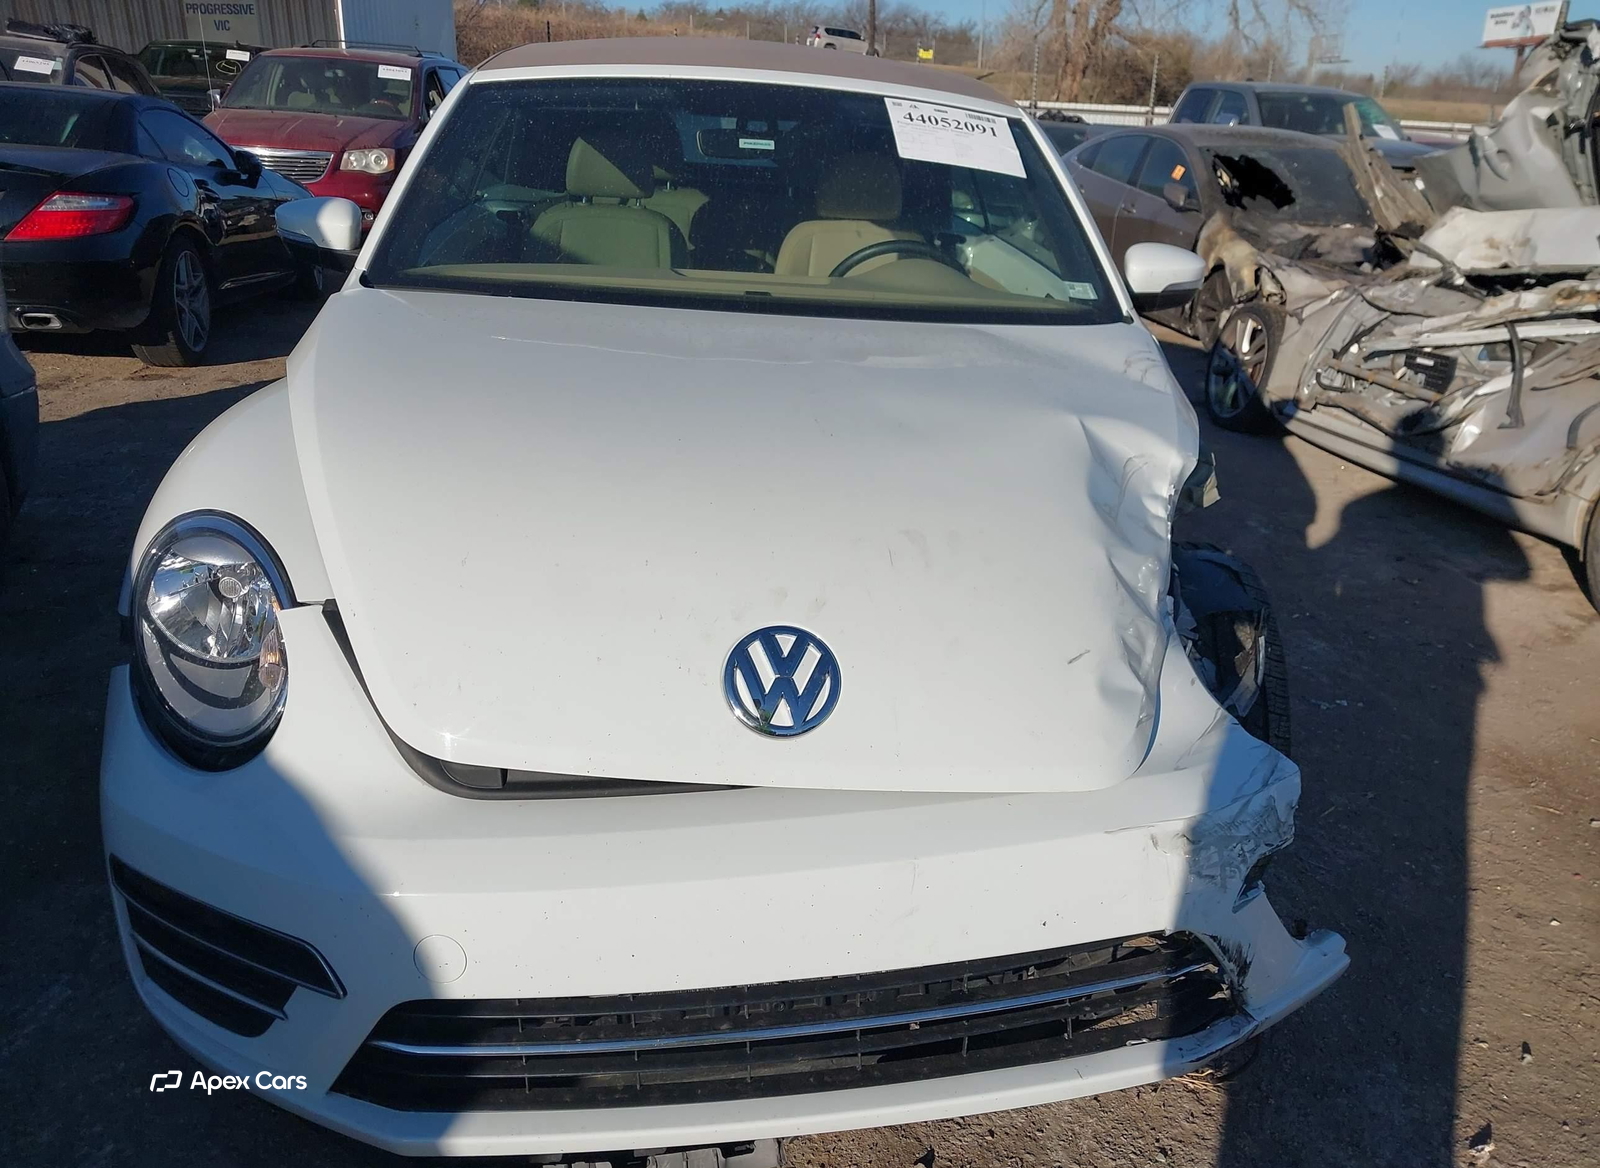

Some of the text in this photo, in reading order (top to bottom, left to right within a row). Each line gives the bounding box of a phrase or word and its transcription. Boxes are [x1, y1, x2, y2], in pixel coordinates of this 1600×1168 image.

[185, 3, 255, 15] PROGRESSIVE
[213, 19, 231, 31] VIC
[903, 111, 998, 138] 44052091
